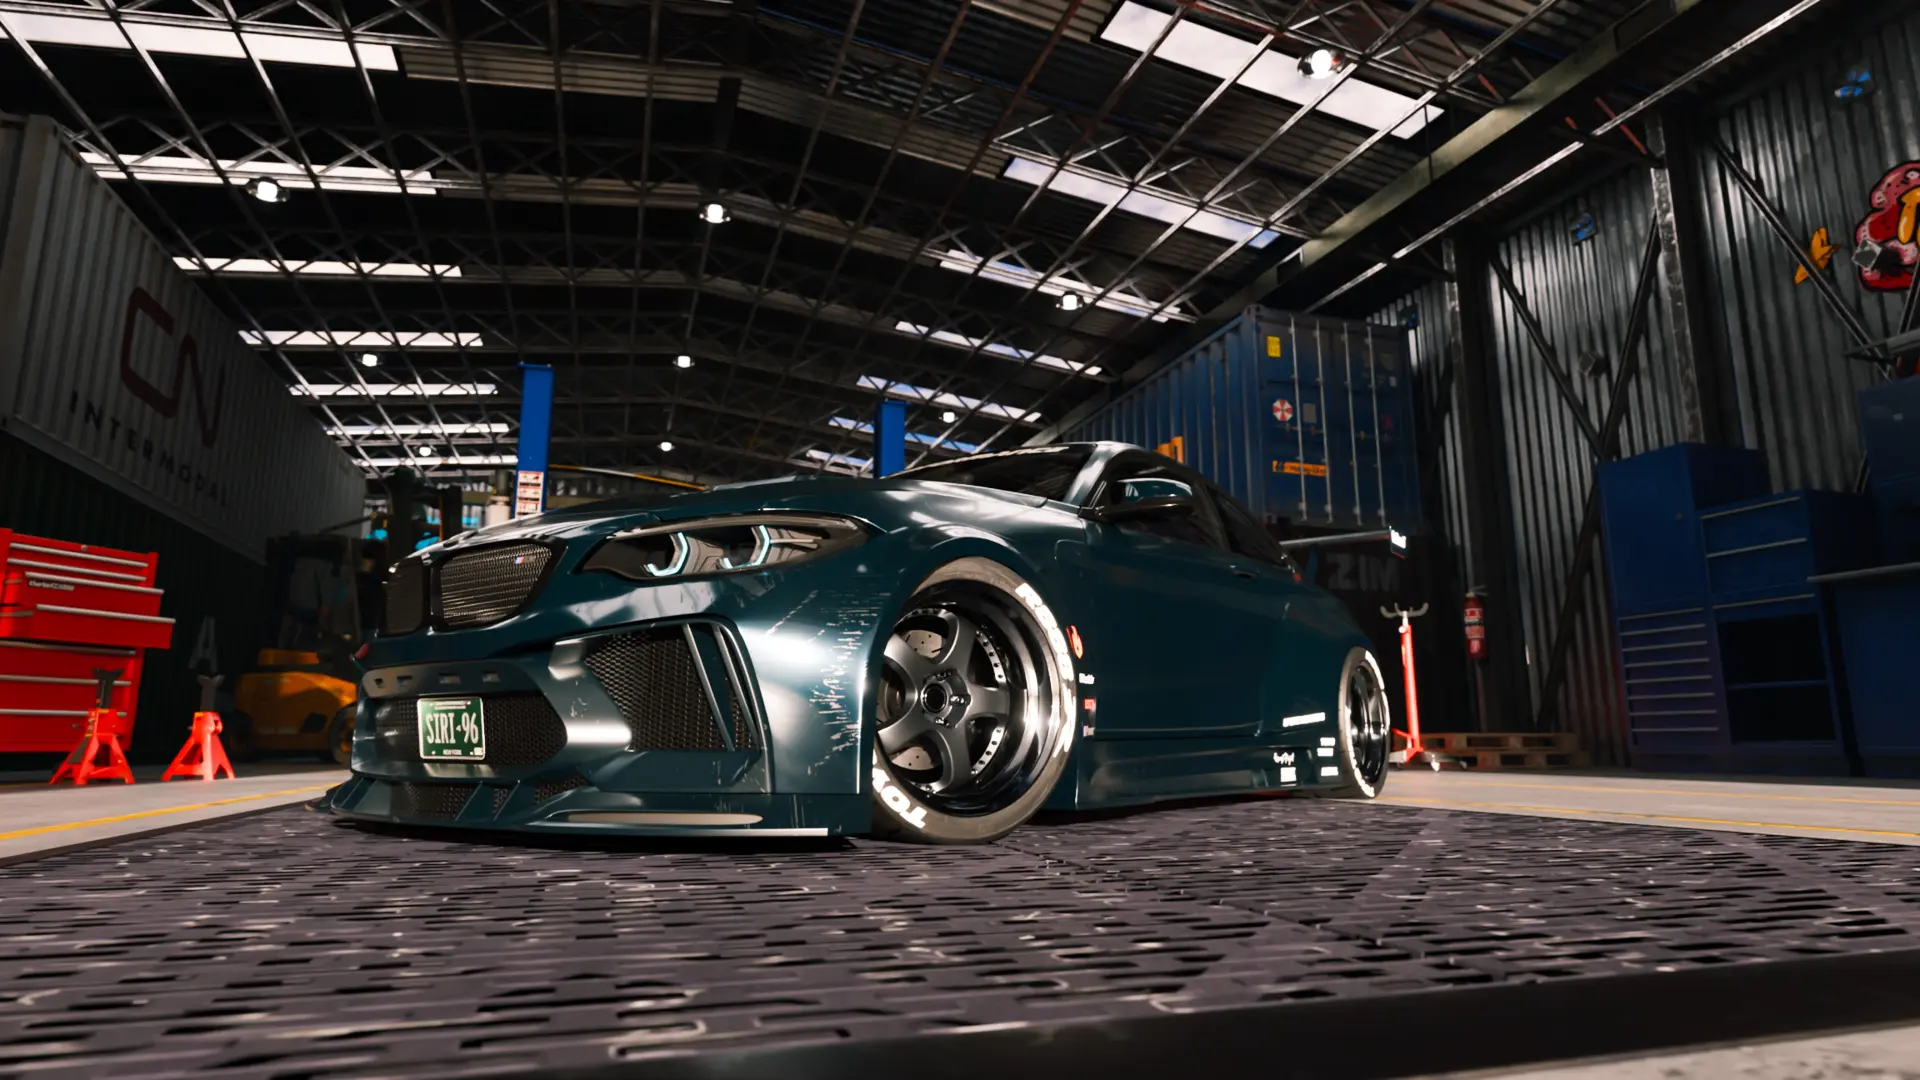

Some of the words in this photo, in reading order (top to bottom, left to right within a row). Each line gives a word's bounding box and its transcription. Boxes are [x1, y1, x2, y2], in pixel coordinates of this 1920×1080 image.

[121, 286, 226, 449] CN
[70, 391, 228, 507] INTERMODAL
[1325, 552, 1400, 592] ZIM
